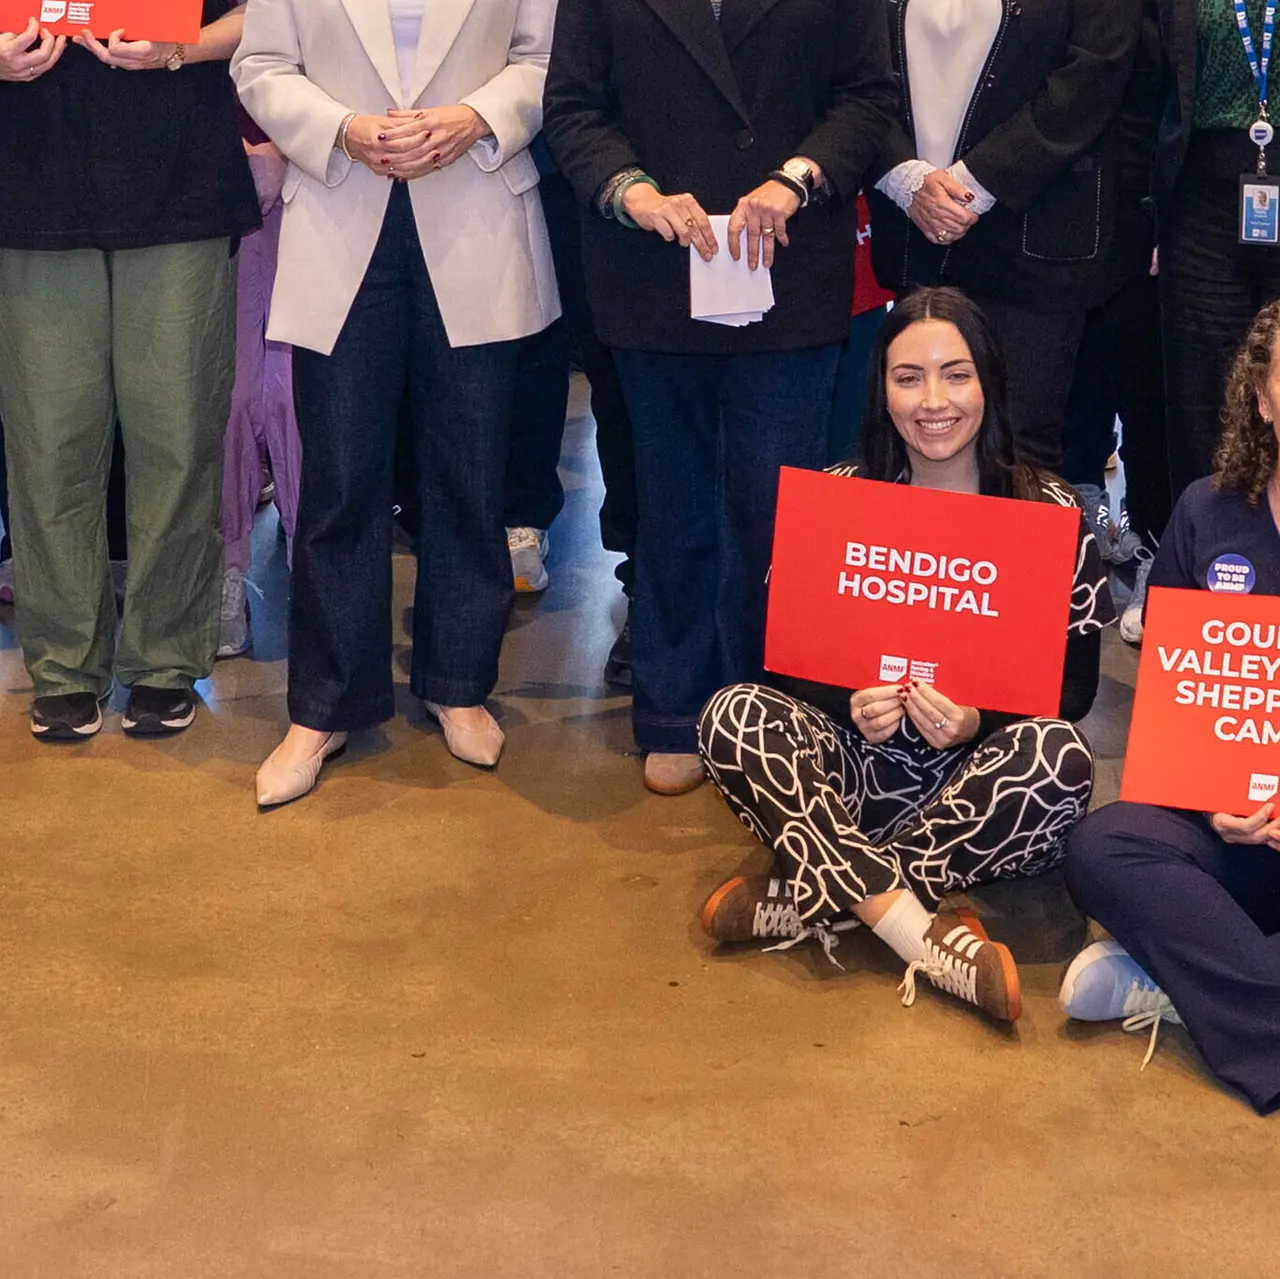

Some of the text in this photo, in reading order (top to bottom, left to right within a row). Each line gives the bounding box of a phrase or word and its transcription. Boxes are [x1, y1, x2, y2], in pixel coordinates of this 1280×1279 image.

[844, 541, 998, 585] BENDIGO
[1214, 563, 1250, 574] PROUD
[1217, 572, 1245, 582] TO BE
[1215, 581, 1245, 591] ANMF
[837, 571, 999, 618] HOSPITAL
